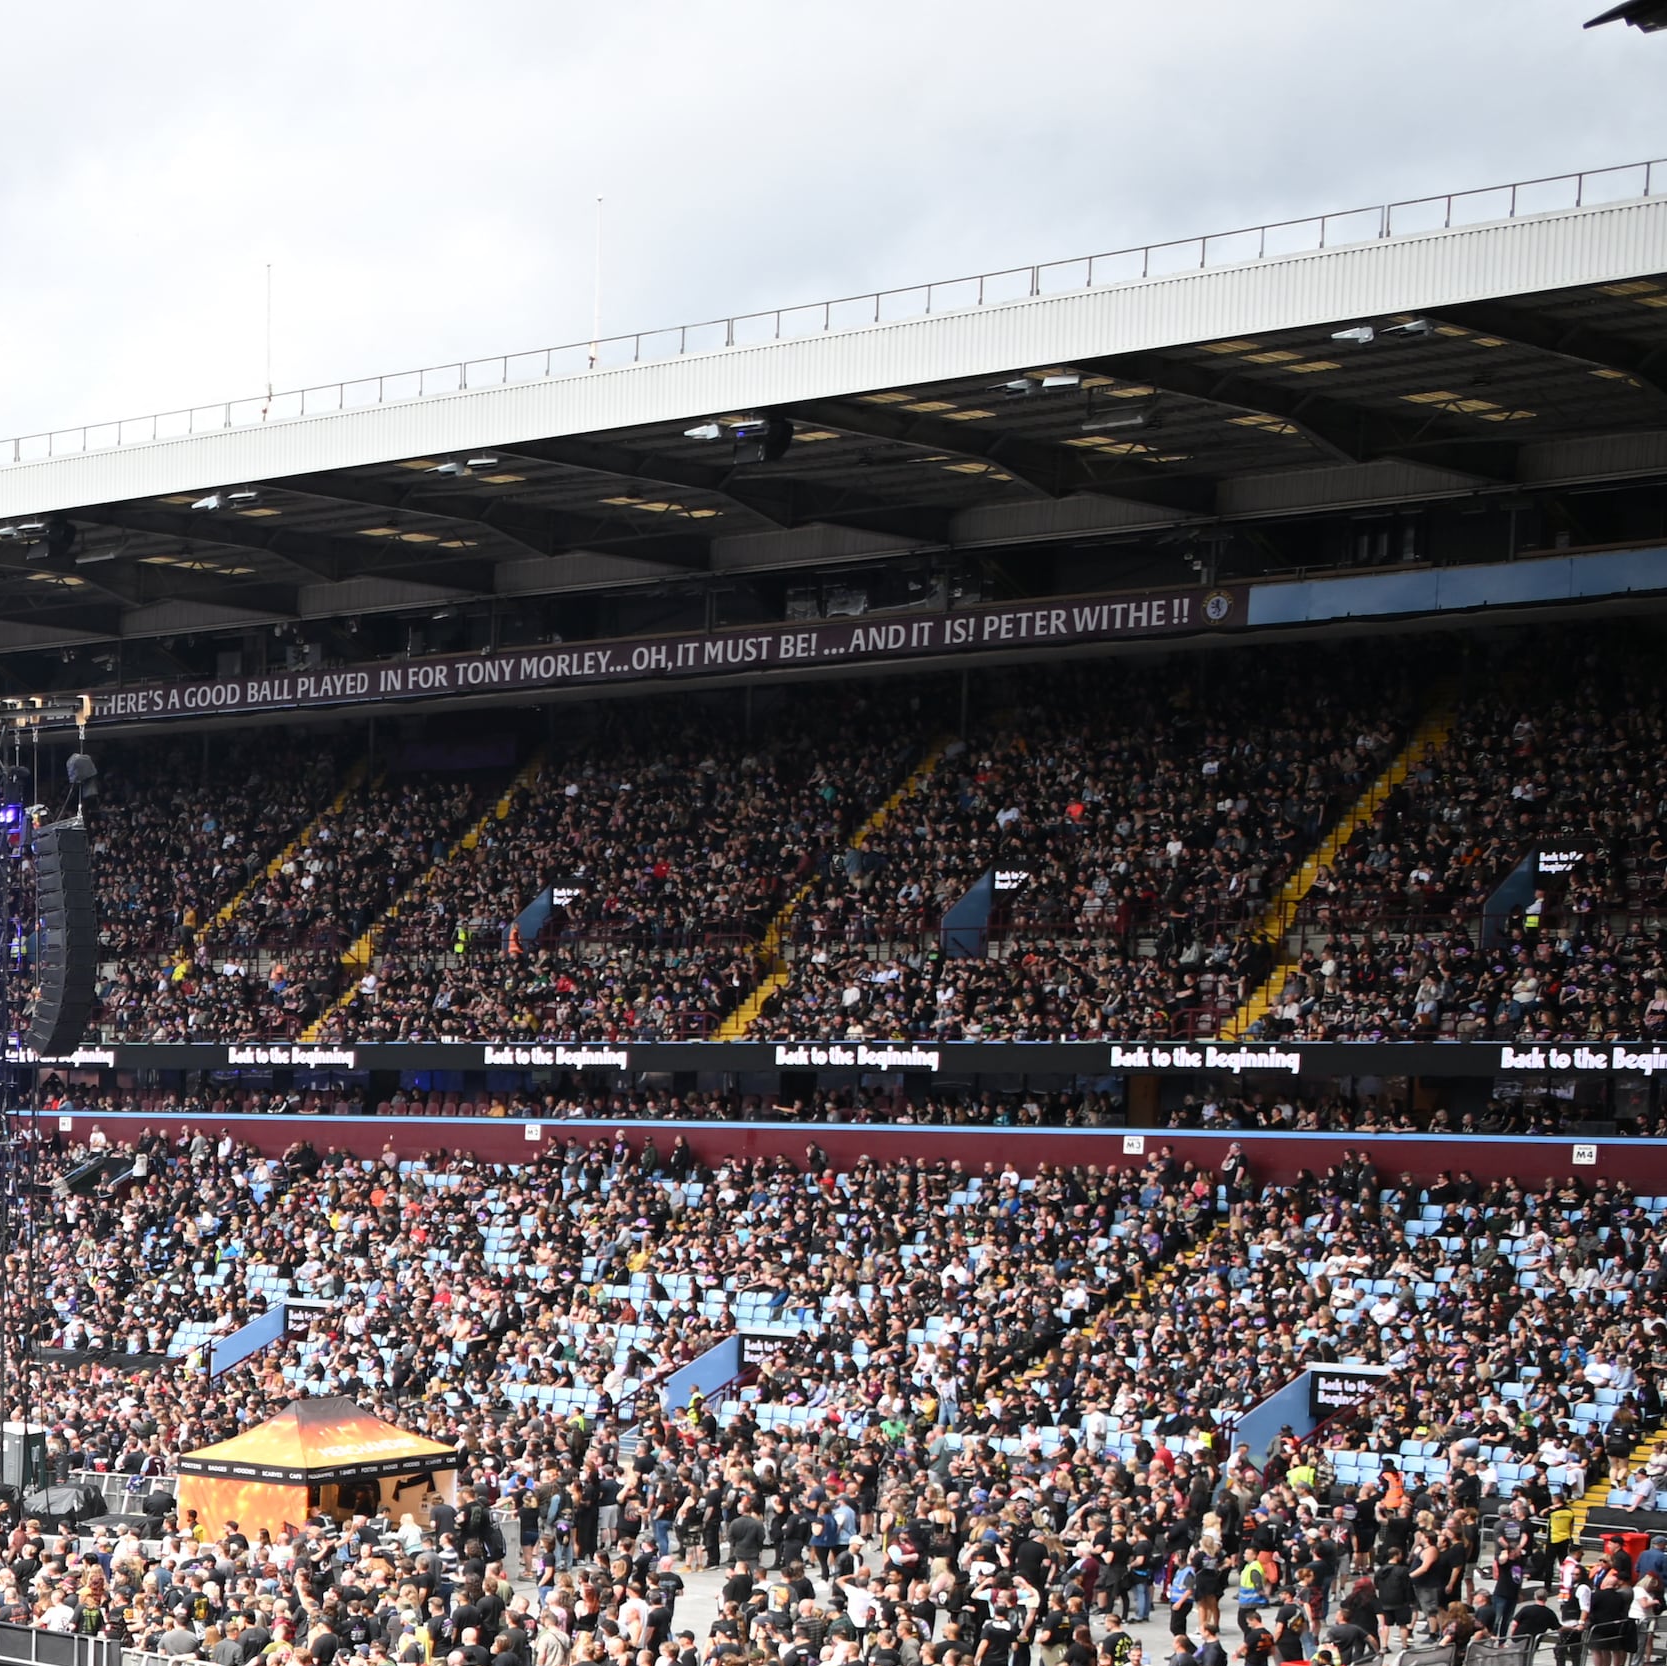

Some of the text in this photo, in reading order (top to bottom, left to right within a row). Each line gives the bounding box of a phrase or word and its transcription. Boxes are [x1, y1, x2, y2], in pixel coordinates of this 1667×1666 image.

[94, 690, 163, 716] THERE'S
[168, 690, 180, 710] A
[184, 683, 240, 709] GOOD
[247, 680, 292, 703] BALL
[297, 672, 368, 698] PLAYED
[380, 669, 401, 691] IN
[408, 666, 447, 690] FOR
[455, 659, 516, 686] TONY
[676, 643, 699, 666] IT
[704, 637, 772, 665] MUST
[779, 633, 818, 659] BE!
[849, 624, 906, 653] AND
[911, 622, 934, 647] IT
[944, 618, 975, 644] IS!
[983, 610, 1067, 641] PETER
[1073, 601, 1165, 633] WITHE
[228, 1047, 354, 1069] Back to the Beginning
[484, 1046, 627, 1070] Back to the Beginning
[775, 1045, 939, 1071] Back to the Beginning
[1110, 1046, 1300, 1074] Back to the Beginning
[1501, 1047, 1546, 1068] Back
[1548, 1048, 1572, 1068] to
[1573, 1047, 1607, 1068] the
[1576, 1151, 1593, 1159] M4
[1318, 1377, 1357, 1391] Back to
[319, 1438, 418, 1457] MERCHANDISE
